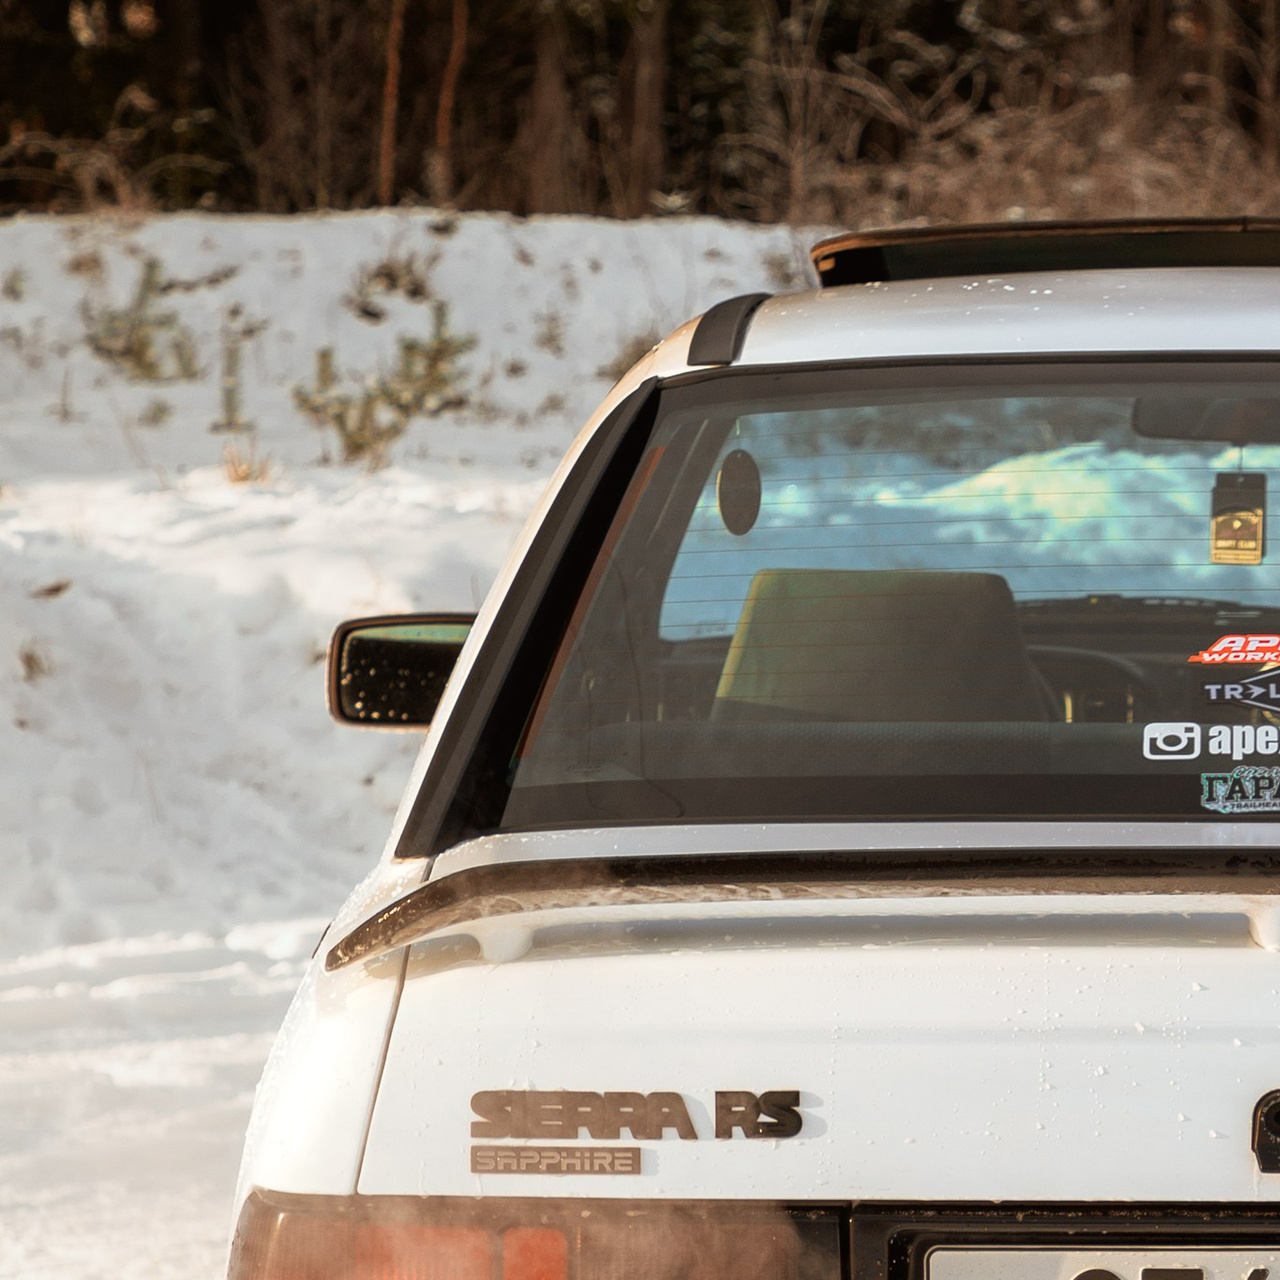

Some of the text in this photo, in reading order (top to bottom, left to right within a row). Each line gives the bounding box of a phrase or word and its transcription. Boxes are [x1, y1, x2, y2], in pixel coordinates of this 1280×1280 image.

[469, 1089, 803, 1140] SIERRA RS
[475, 1150, 634, 1172] SAPPHIRE
